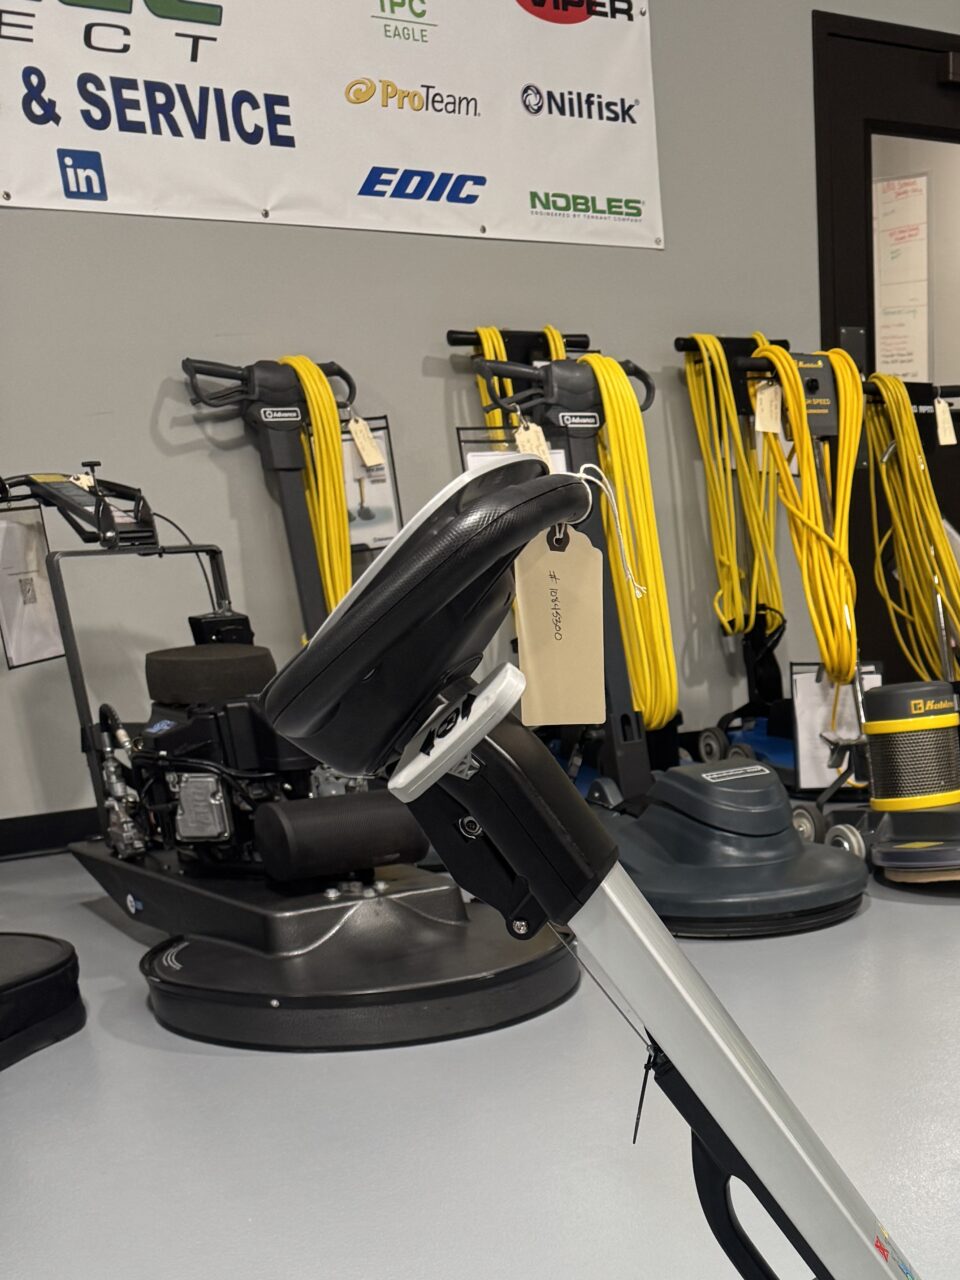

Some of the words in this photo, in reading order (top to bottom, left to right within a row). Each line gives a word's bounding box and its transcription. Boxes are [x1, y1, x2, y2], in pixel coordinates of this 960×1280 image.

[384, 24, 428, 43] EAGLE
[22, 66, 62, 127] &
[77, 72, 296, 148] SERVICE
[379, 79, 479, 117] ProTeam
[547, 90, 638, 124] Nilfisk
[64, 156, 101, 194] in
[357, 166, 487, 204] EDIC
[529, 191, 643, 217] NOBLES
